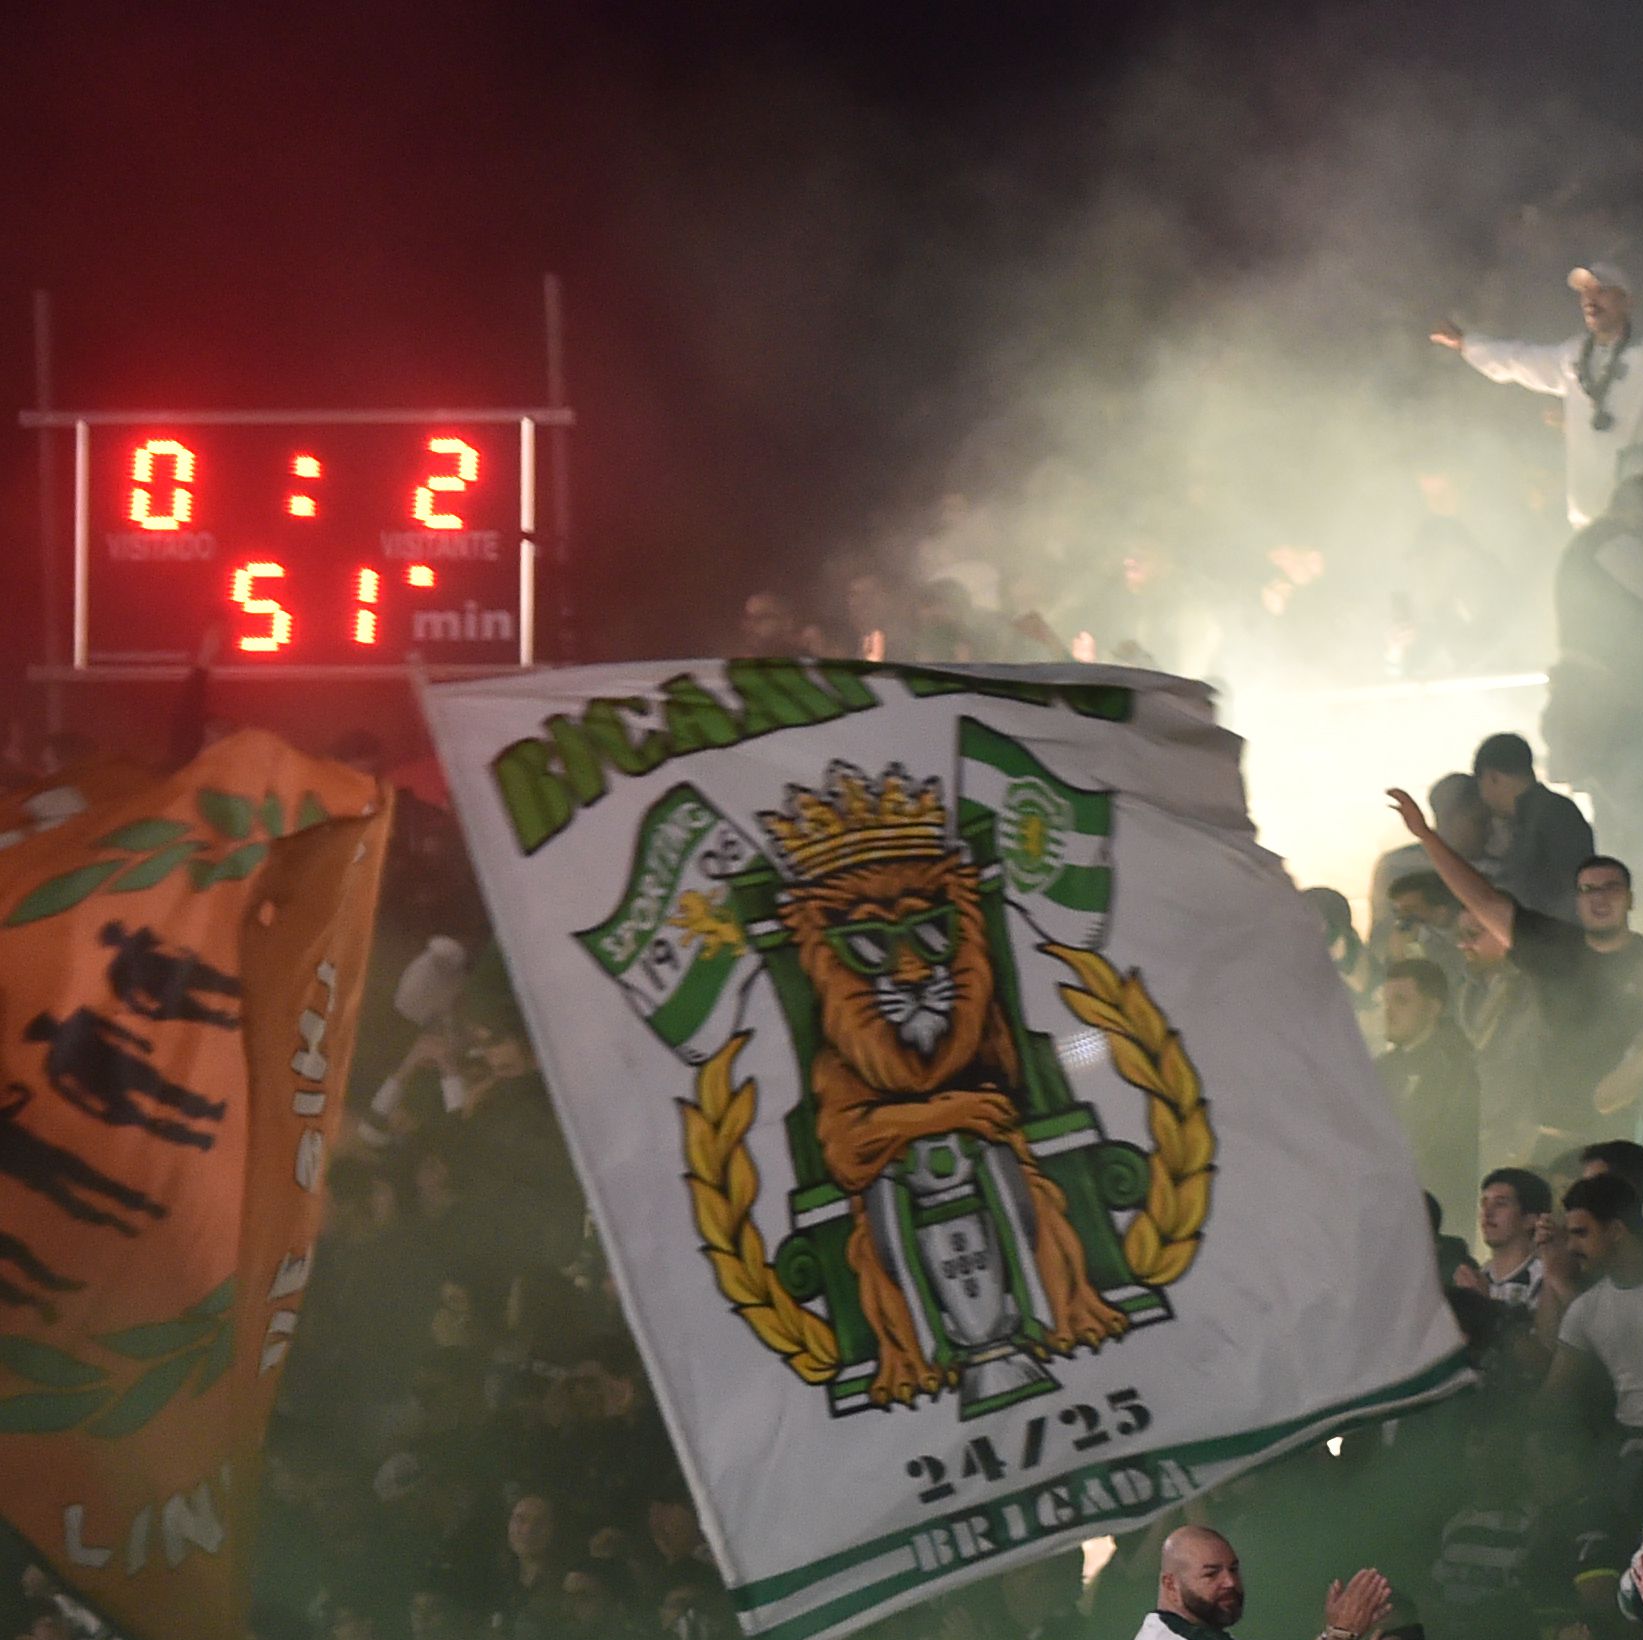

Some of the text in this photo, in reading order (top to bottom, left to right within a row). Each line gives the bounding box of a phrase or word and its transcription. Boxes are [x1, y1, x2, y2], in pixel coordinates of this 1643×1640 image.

[129, 438, 196, 530] 0
[412, 437, 481, 530] 2
[380, 531, 499, 561] VISITANTE
[412, 602, 513, 641] min
[904, 1388, 1154, 1503] 24/25
[908, 1456, 1200, 1573] BRIGADA
